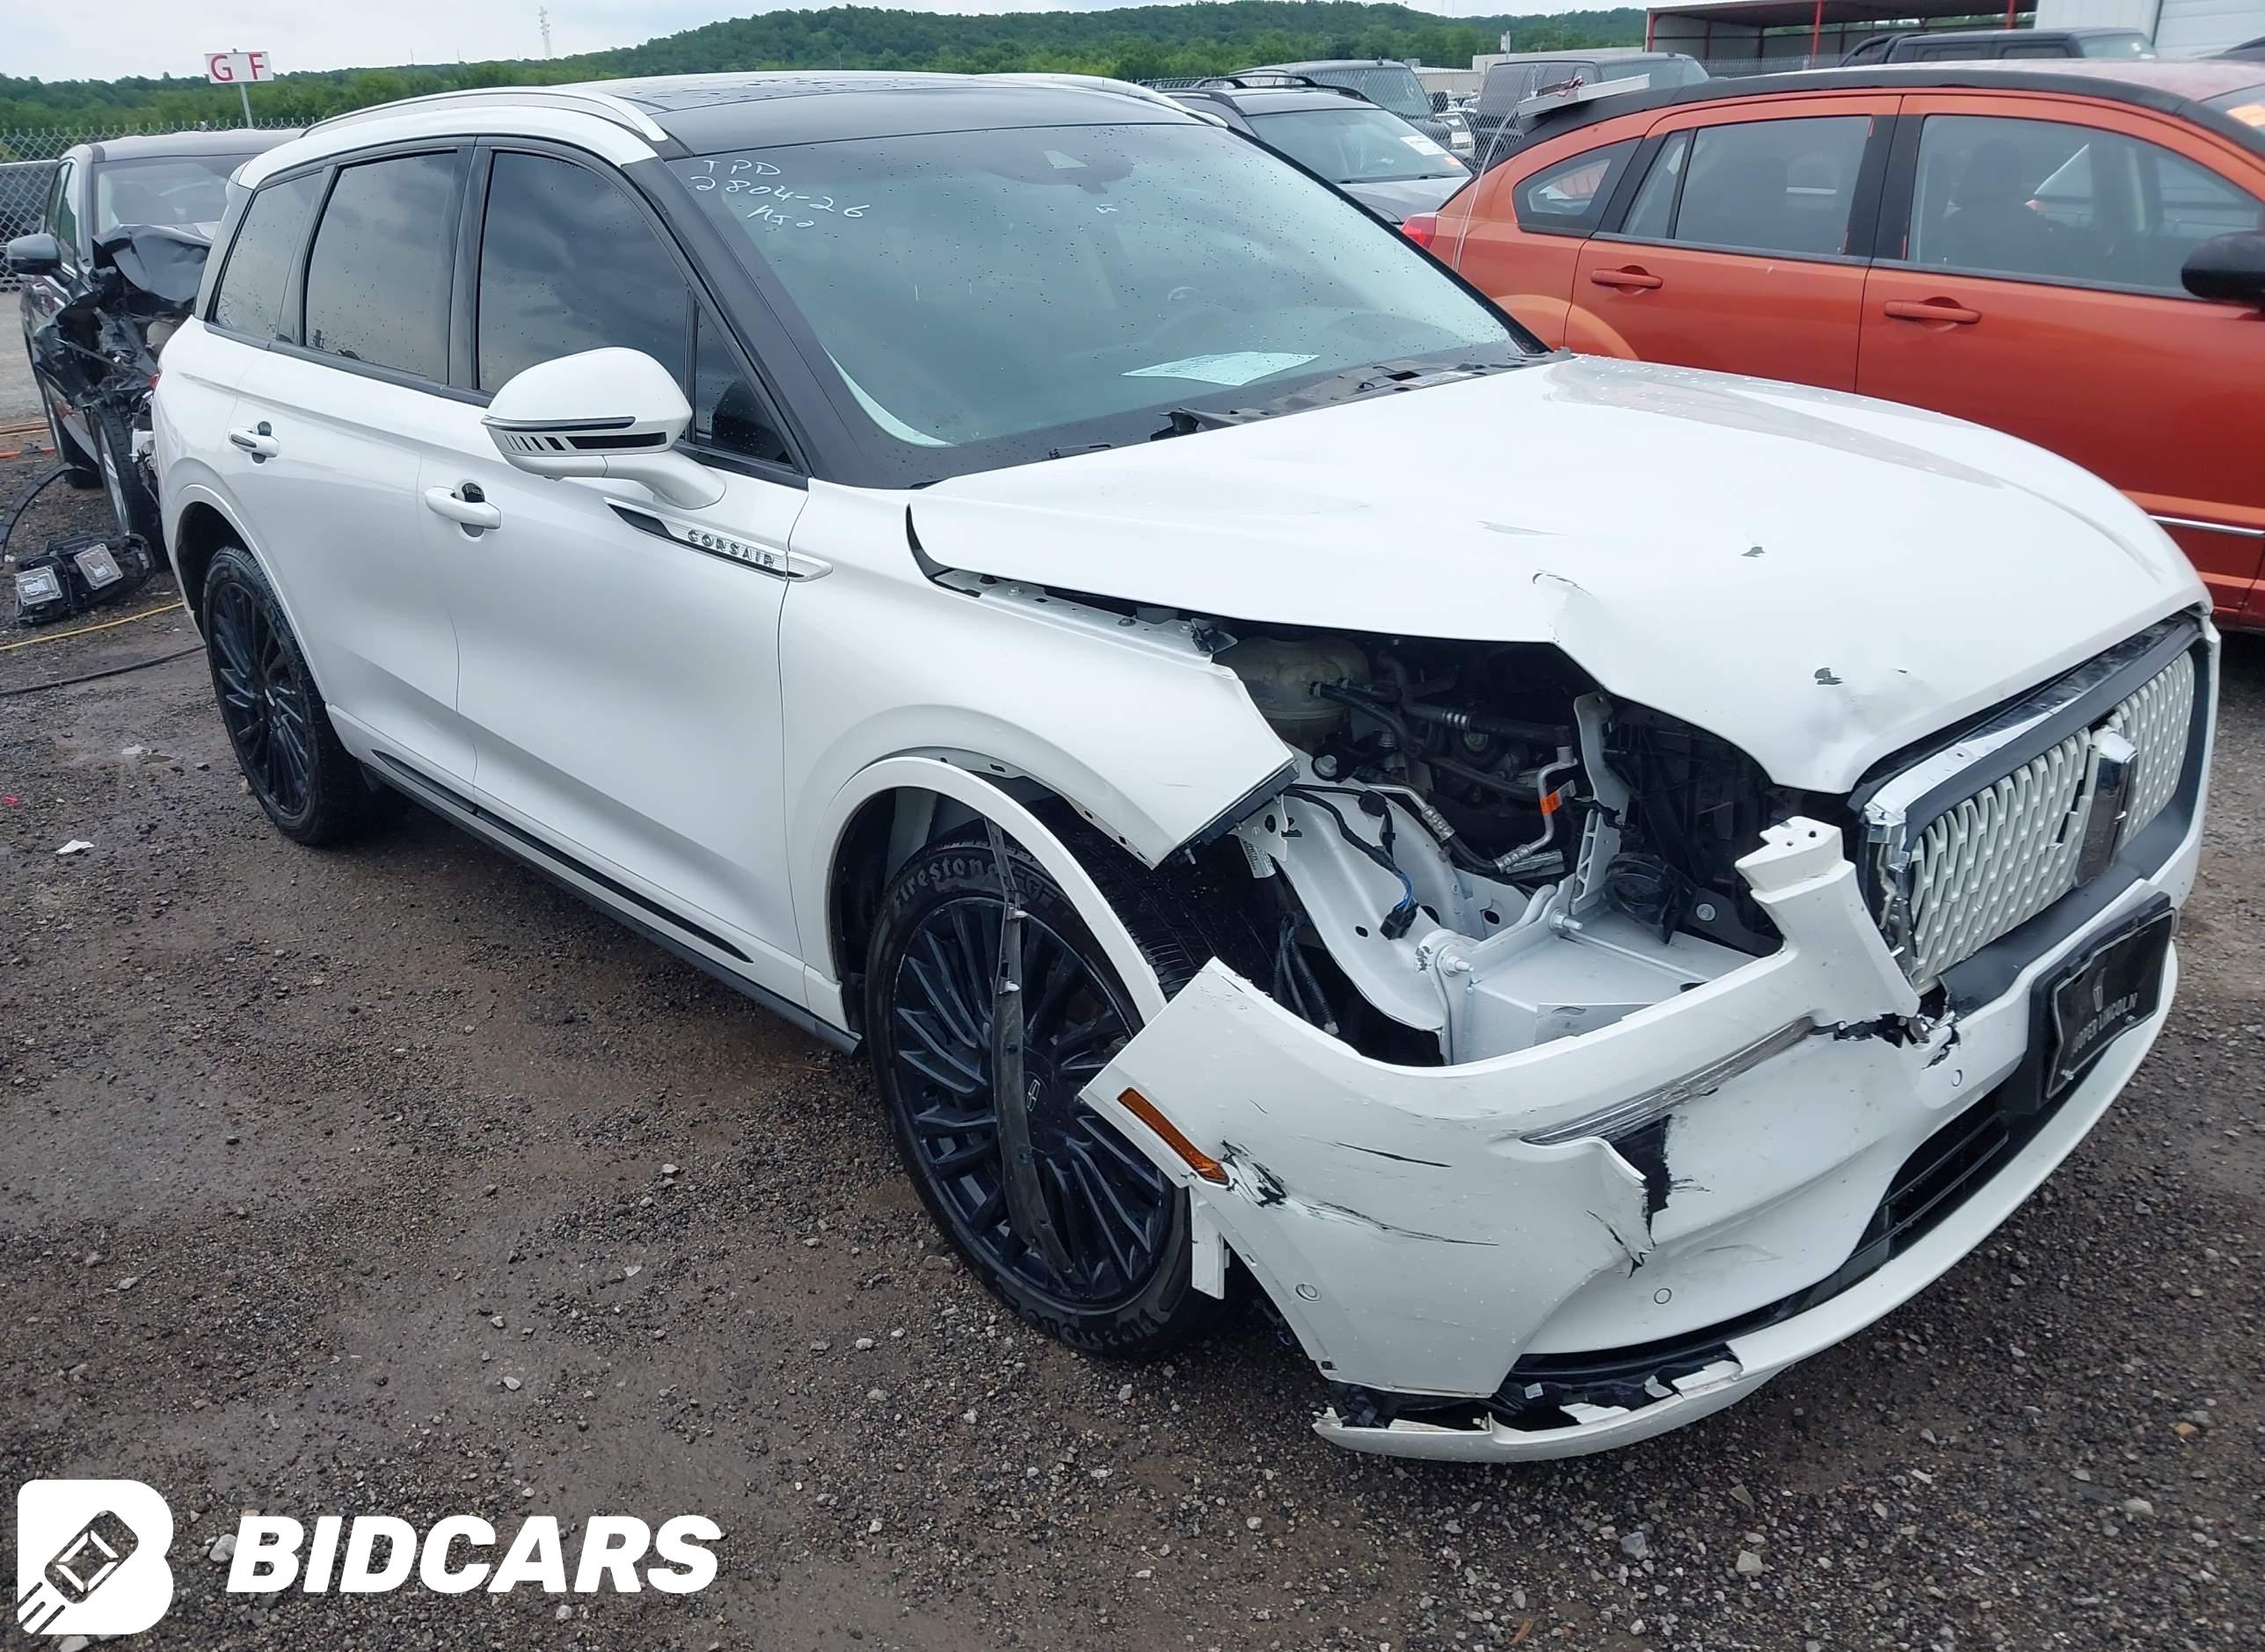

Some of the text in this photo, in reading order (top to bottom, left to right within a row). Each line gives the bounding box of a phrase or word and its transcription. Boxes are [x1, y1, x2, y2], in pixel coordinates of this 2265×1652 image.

[210, 53, 265, 82] G F
[688, 528, 775, 567] CORSAIR
